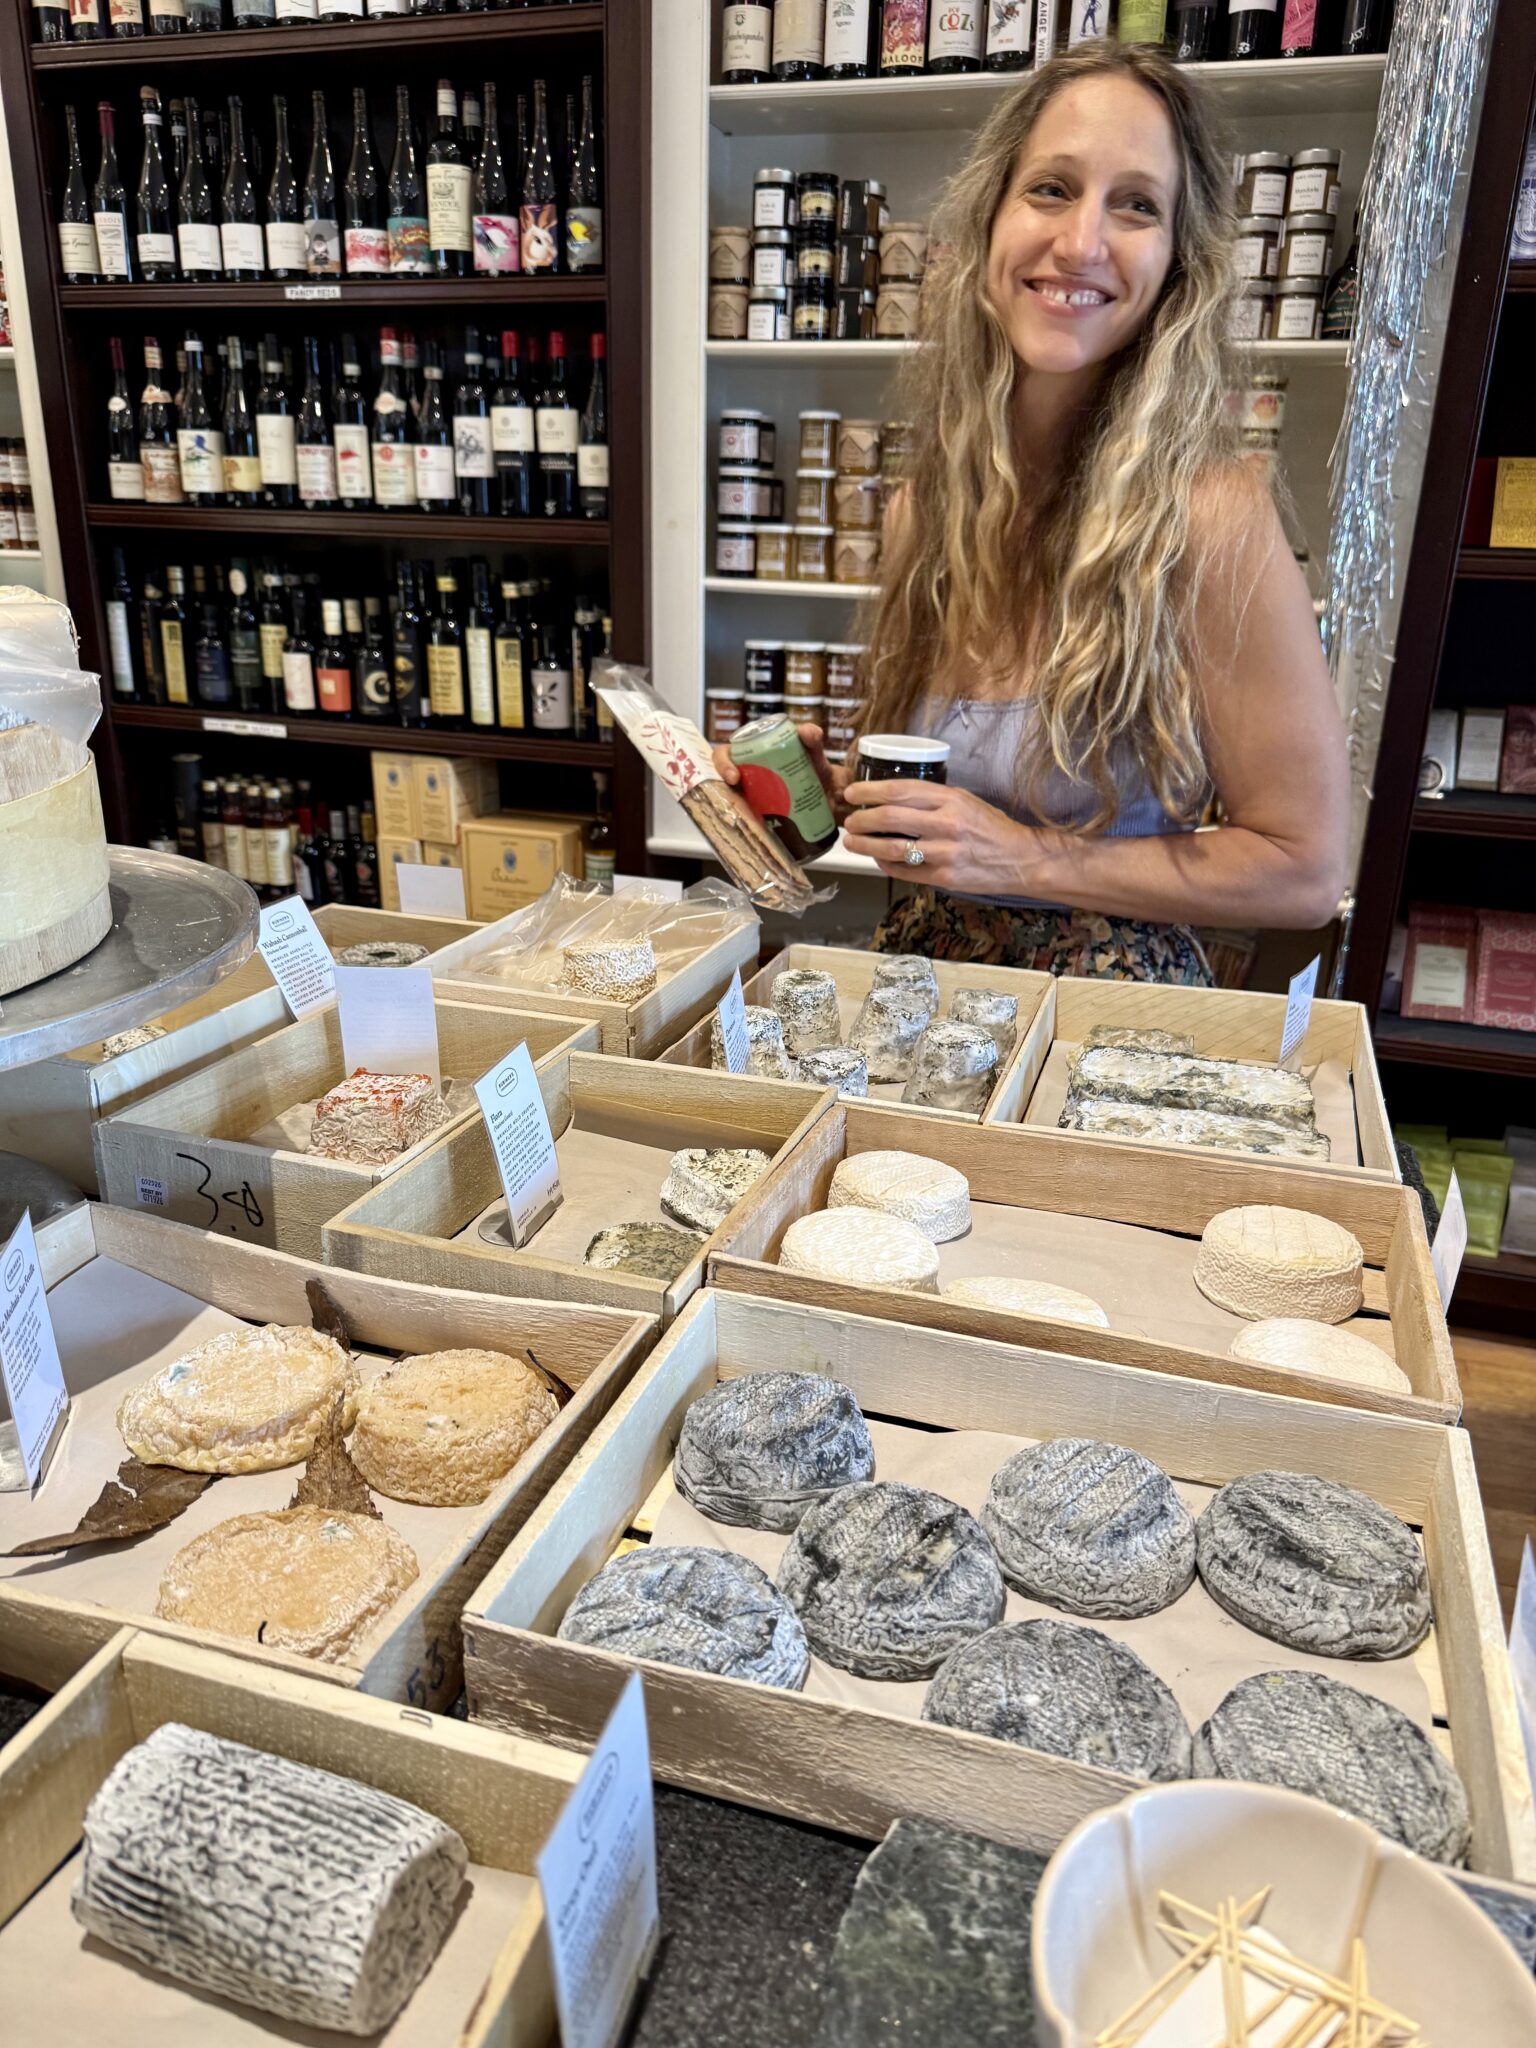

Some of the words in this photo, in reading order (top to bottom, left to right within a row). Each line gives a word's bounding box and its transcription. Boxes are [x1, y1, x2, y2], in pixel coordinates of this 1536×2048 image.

[882, 54, 923, 64] MALOOF
[262, 936, 282, 949] Wabash
[282, 925, 306, 940] Cannonball
